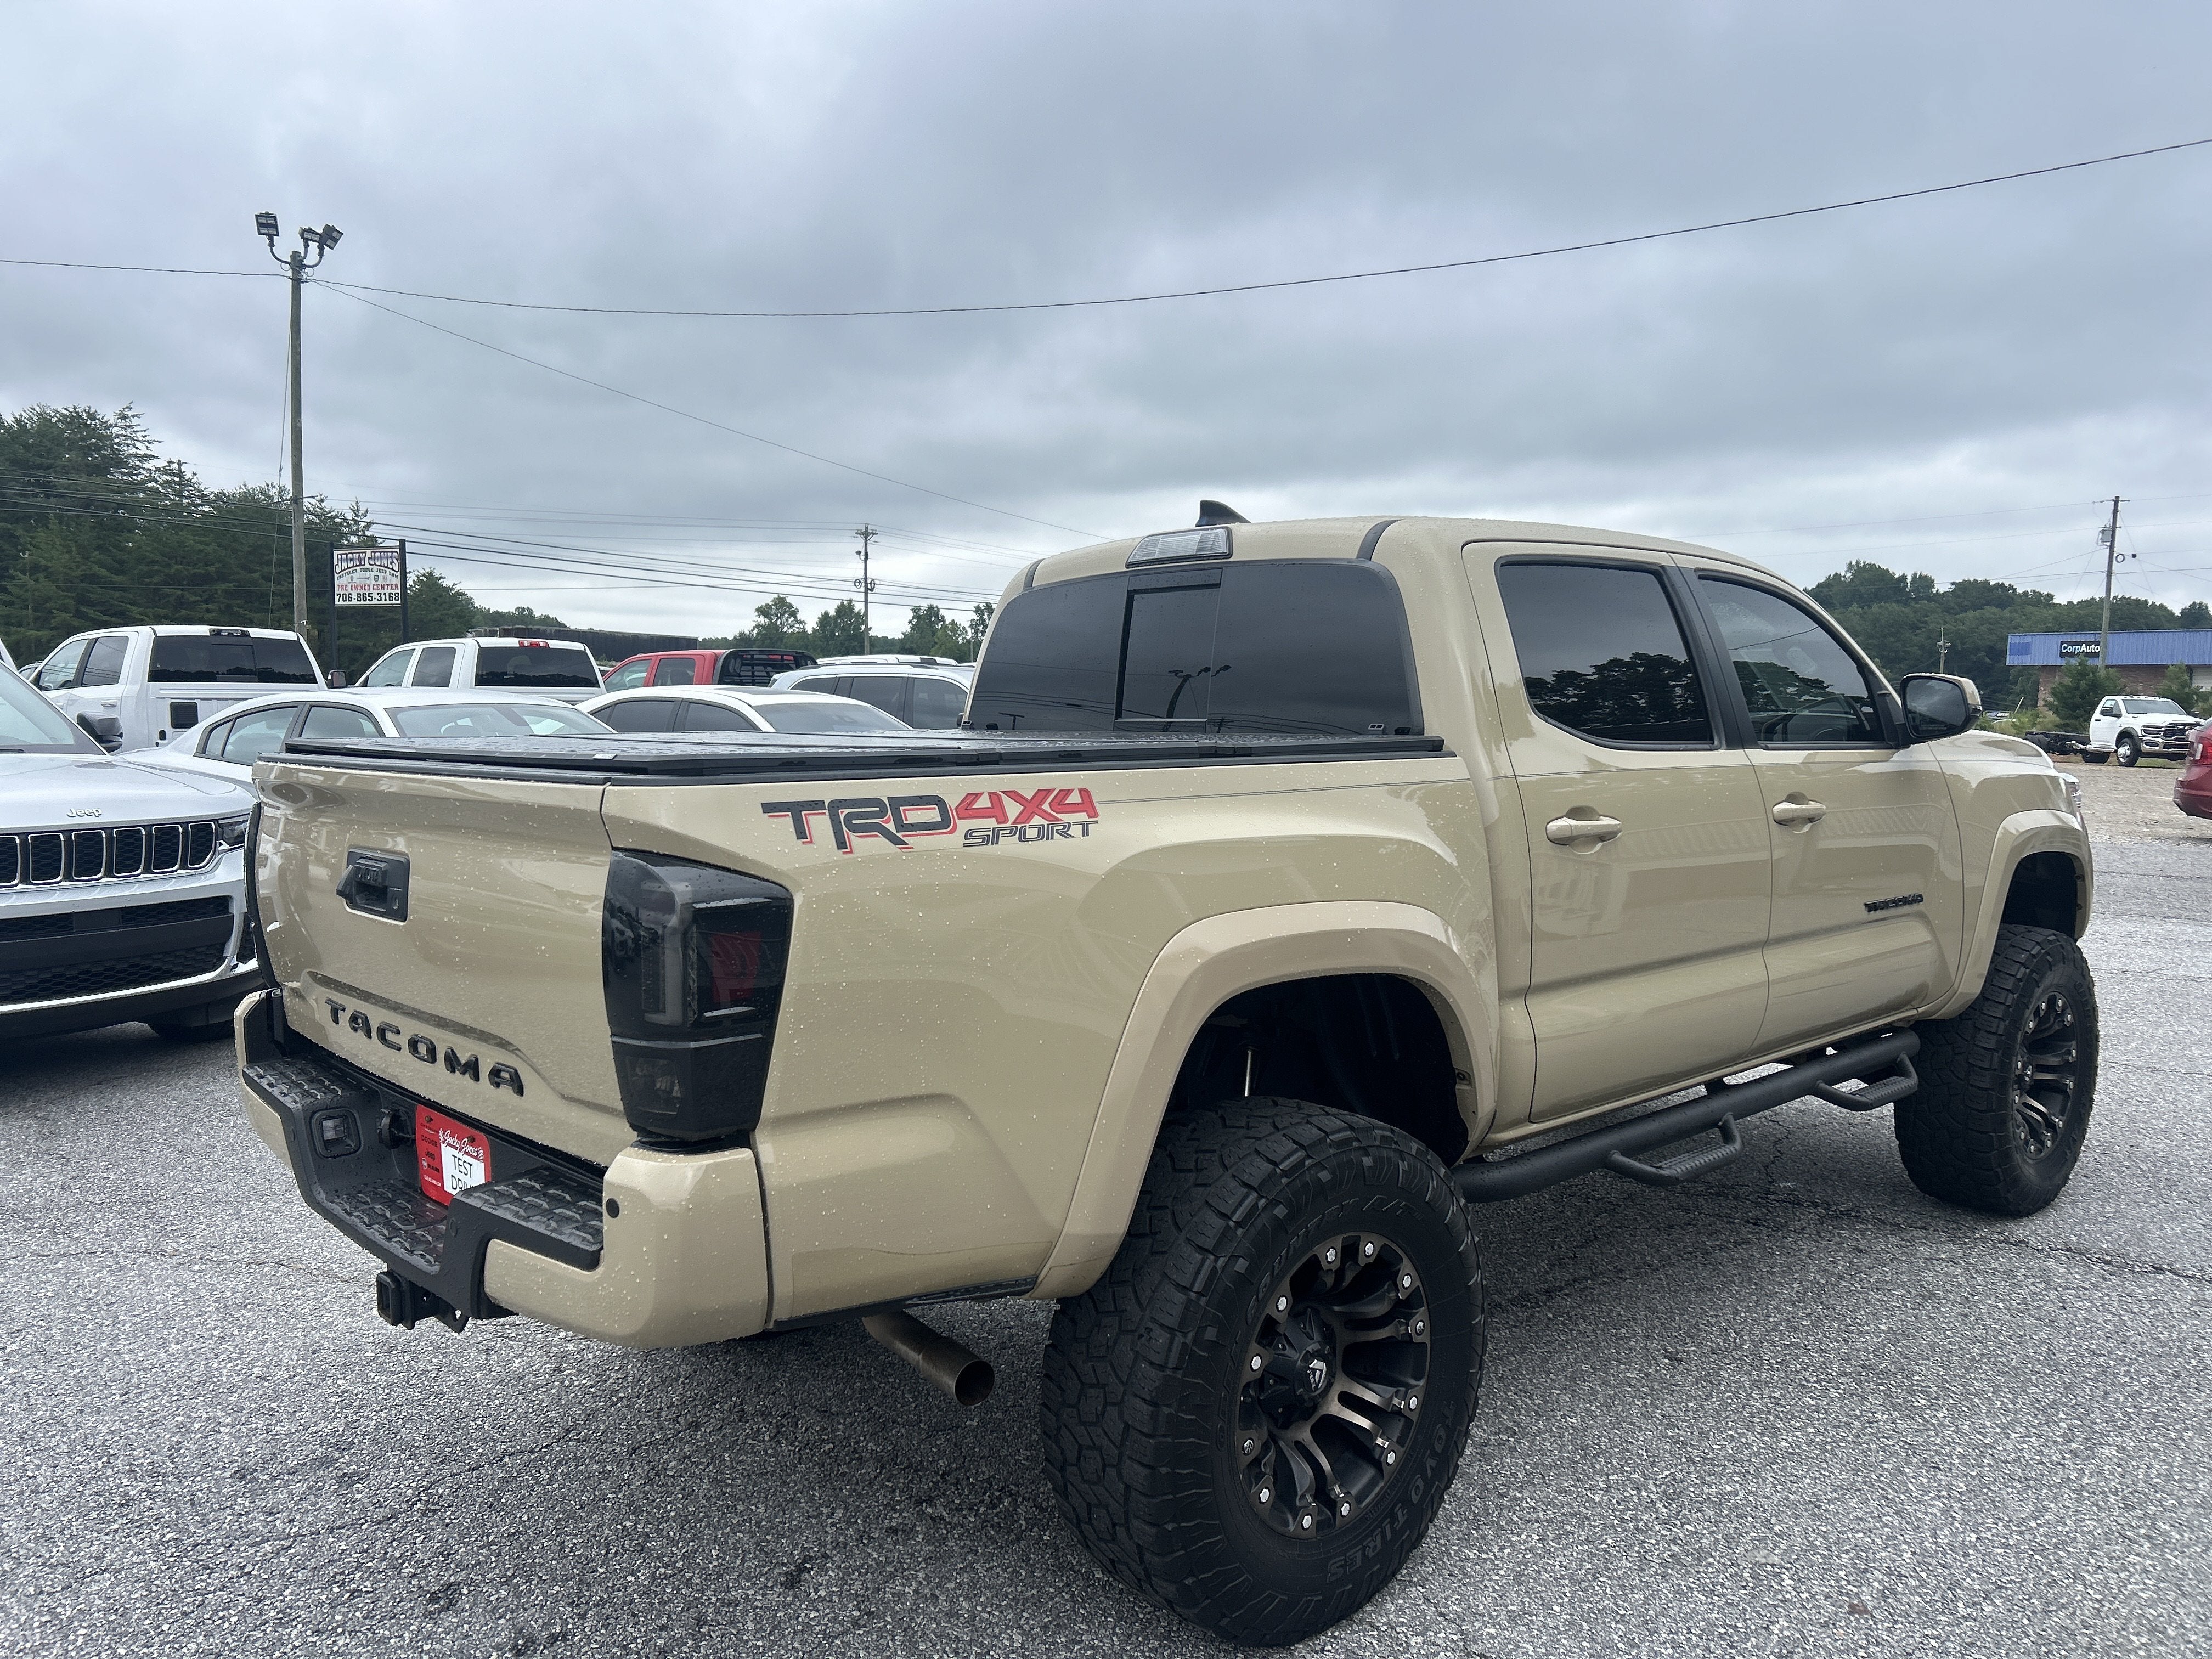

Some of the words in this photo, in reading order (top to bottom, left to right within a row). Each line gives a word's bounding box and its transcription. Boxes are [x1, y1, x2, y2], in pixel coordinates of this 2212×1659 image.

[335, 551, 367, 574] JACKY
[368, 551, 399, 573] JONES
[336, 592, 399, 602] 706-865-3168
[2061, 644, 2101, 654] CorpAuto
[66, 808, 103, 818] Jeep
[761, 794, 957, 855] TRD
[962, 820, 1099, 848] SPORT
[324, 997, 525, 1097] TACOMA
[421, 1135, 438, 1148] DODGE
[452, 1154, 473, 1178] TEST
[450, 1174, 473, 1191] DRI
